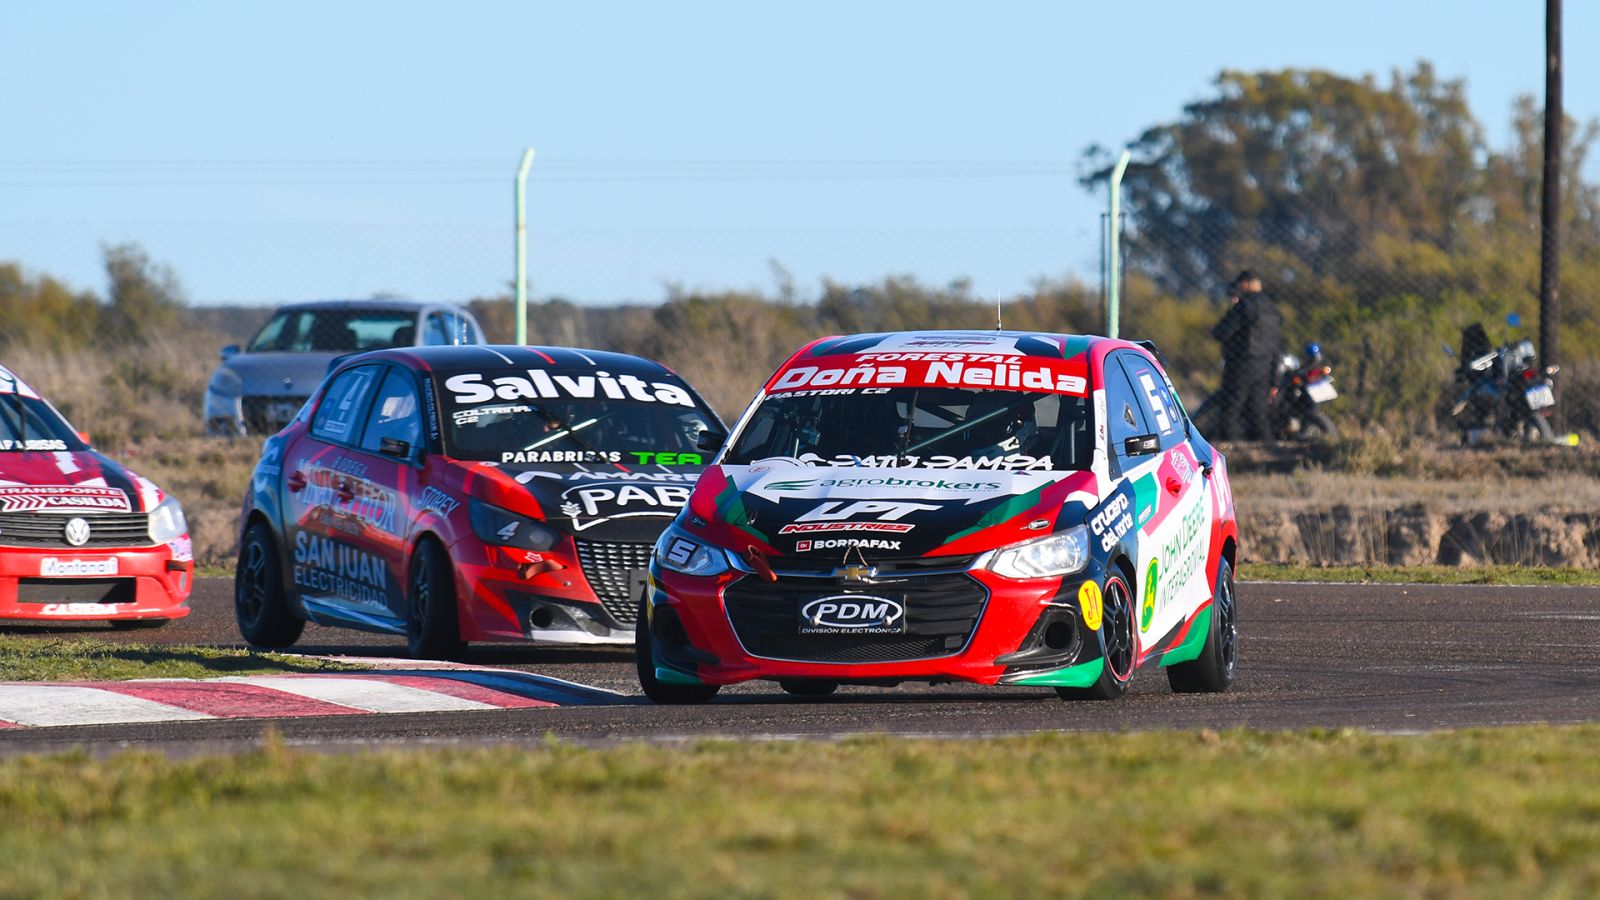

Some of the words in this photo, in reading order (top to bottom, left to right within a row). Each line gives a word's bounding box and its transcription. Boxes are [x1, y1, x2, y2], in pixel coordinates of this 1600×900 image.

[855, 354, 1023, 364] FORESTAL
[769, 362, 907, 391] Doña
[924, 360, 1088, 394] Nelida
[445, 369, 696, 408] Salvita
[765, 389, 856, 401] PASTORI
[1139, 374, 1170, 431] 5
[455, 416, 479, 425] C2
[629, 451, 702, 465] TEA
[922, 453, 1055, 471] PAMPA
[820, 477, 1002, 490] agrobrokers
[47, 496, 126, 508] CASILDA
[794, 501, 944, 522] LPT
[497, 521, 520, 540] 4
[780, 522, 915, 534] INDUSTRIES
[814, 539, 901, 550] BORDAFAX
[1101, 526, 1120, 553] del
[1158, 529, 1182, 582] JOHN
[1182, 494, 1206, 550] DEERE
[294, 530, 335, 572] SAN
[338, 543, 386, 590] JUAN
[667, 541, 697, 565] 5
[294, 565, 388, 611] ELECTRICIDAD
[815, 603, 889, 620] PDM
